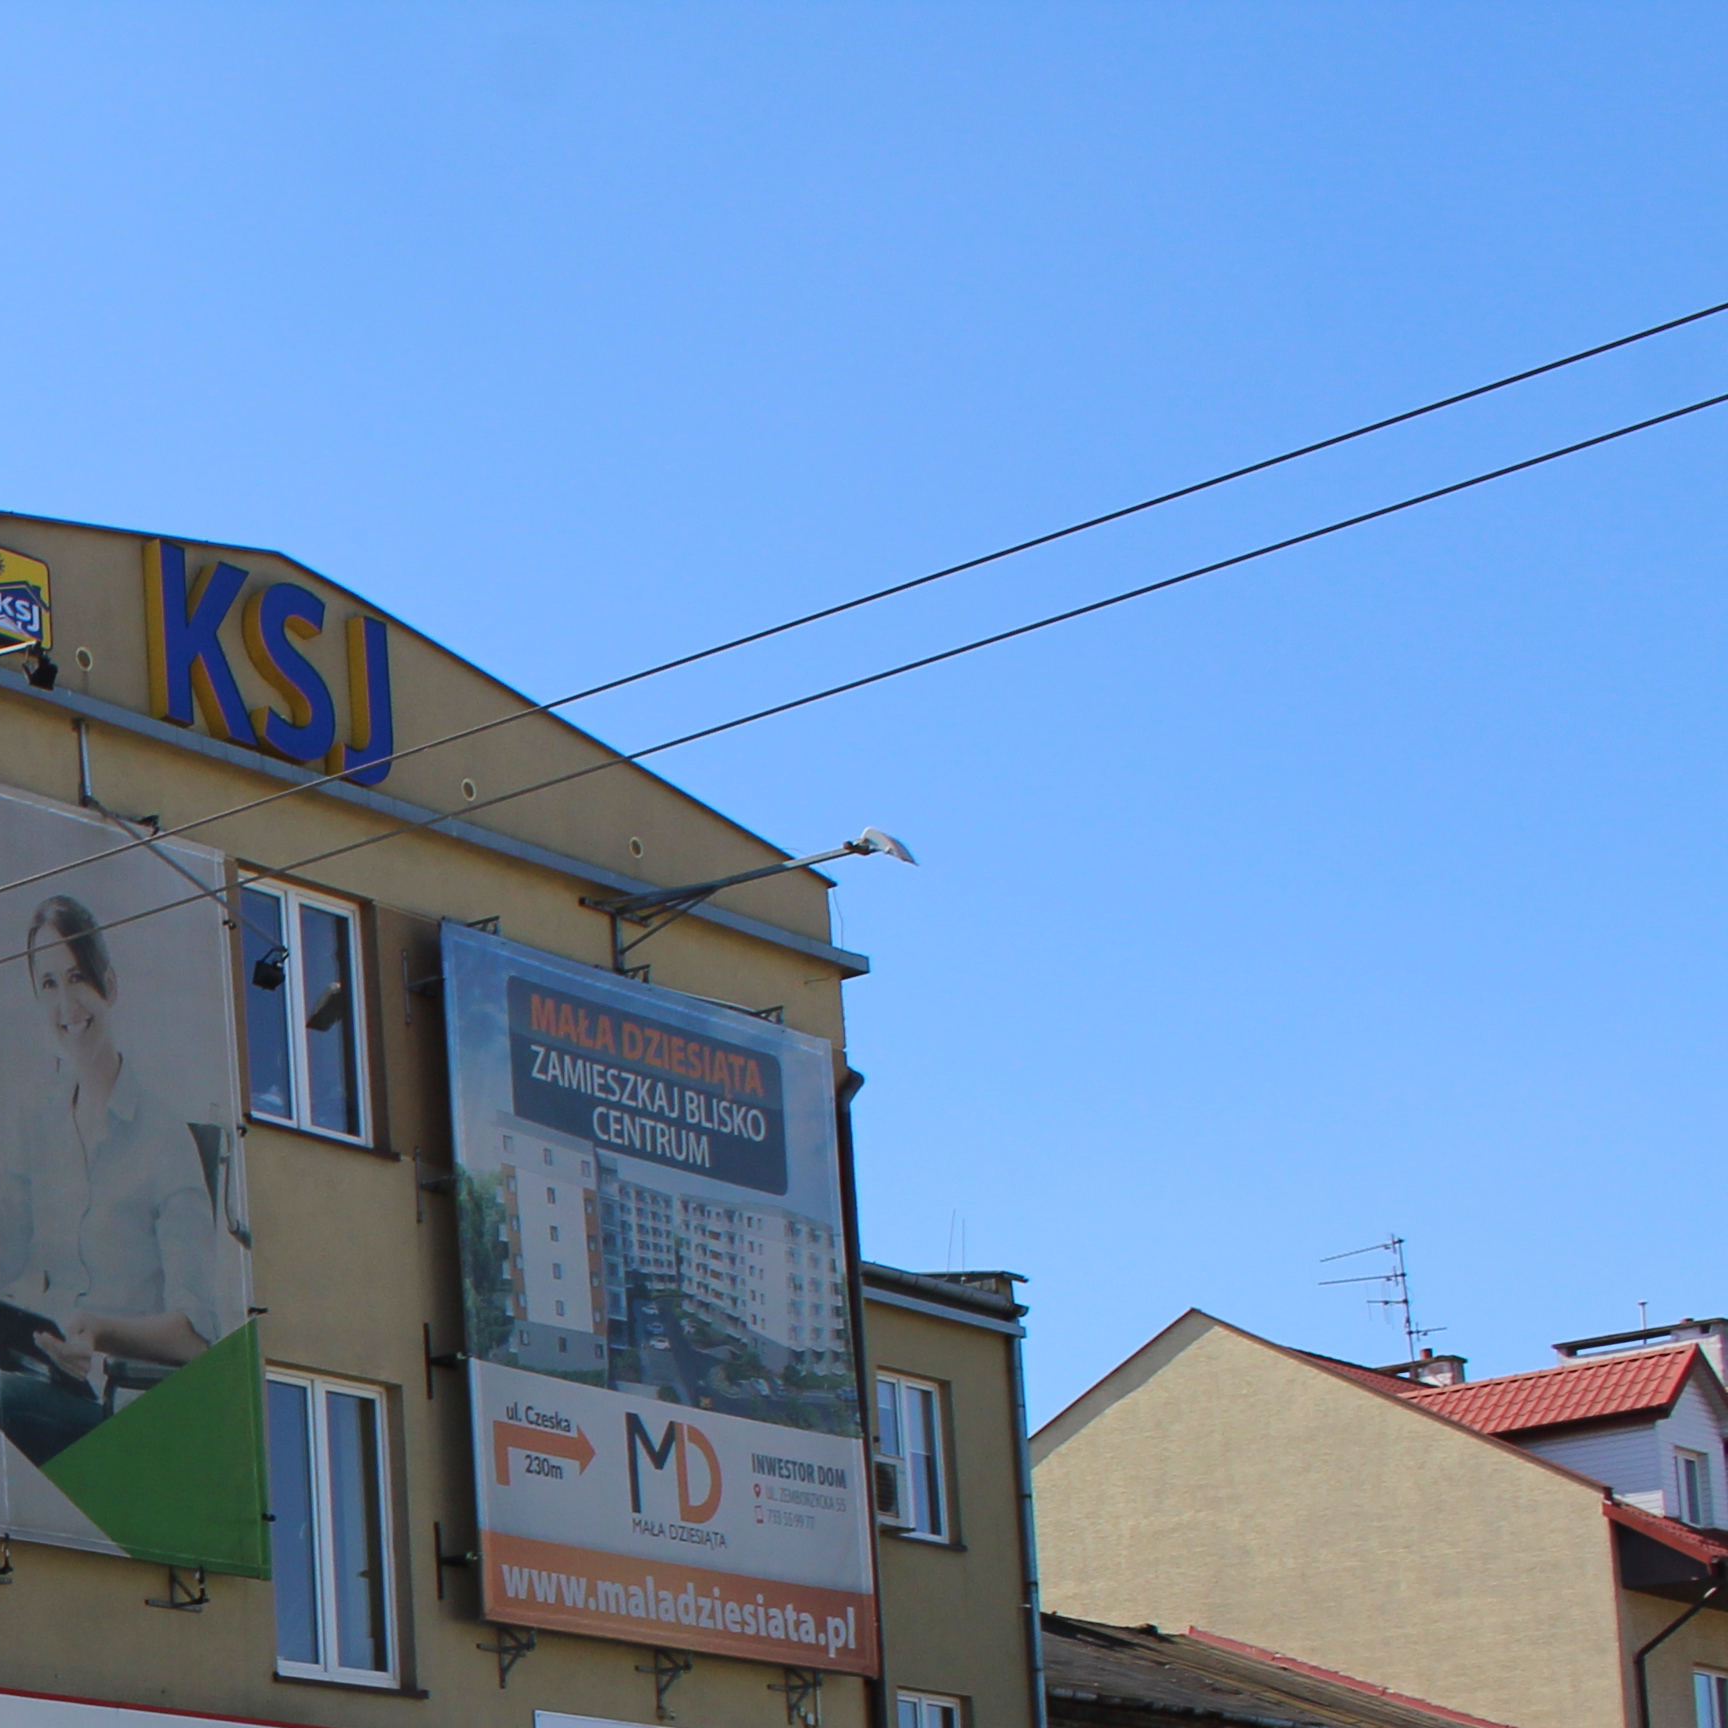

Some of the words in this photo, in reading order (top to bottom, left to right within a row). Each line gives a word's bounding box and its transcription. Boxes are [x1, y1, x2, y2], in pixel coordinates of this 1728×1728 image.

[144, 537, 394, 787] KSJ
[529, 992, 616, 1056] MAŁA
[621, 1018, 766, 1098] DZIESIĄTA
[529, 1045, 682, 1119] ZAMIESZKAJ
[684, 1087, 767, 1143] BLISKO
[591, 1105, 711, 1169] CENTRUM
[506, 1402, 521, 1422] ul.
[525, 1405, 572, 1433] Czeska
[525, 1454, 563, 1480] 230m
[751, 1453, 815, 1484] INWESTOR
[817, 1465, 847, 1489] DOM
[632, 1517, 665, 1538] MAŁA
[669, 1524, 727, 1550] DZIESIĄTA
[502, 1560, 857, 1656] www.maladziesiata.pl
